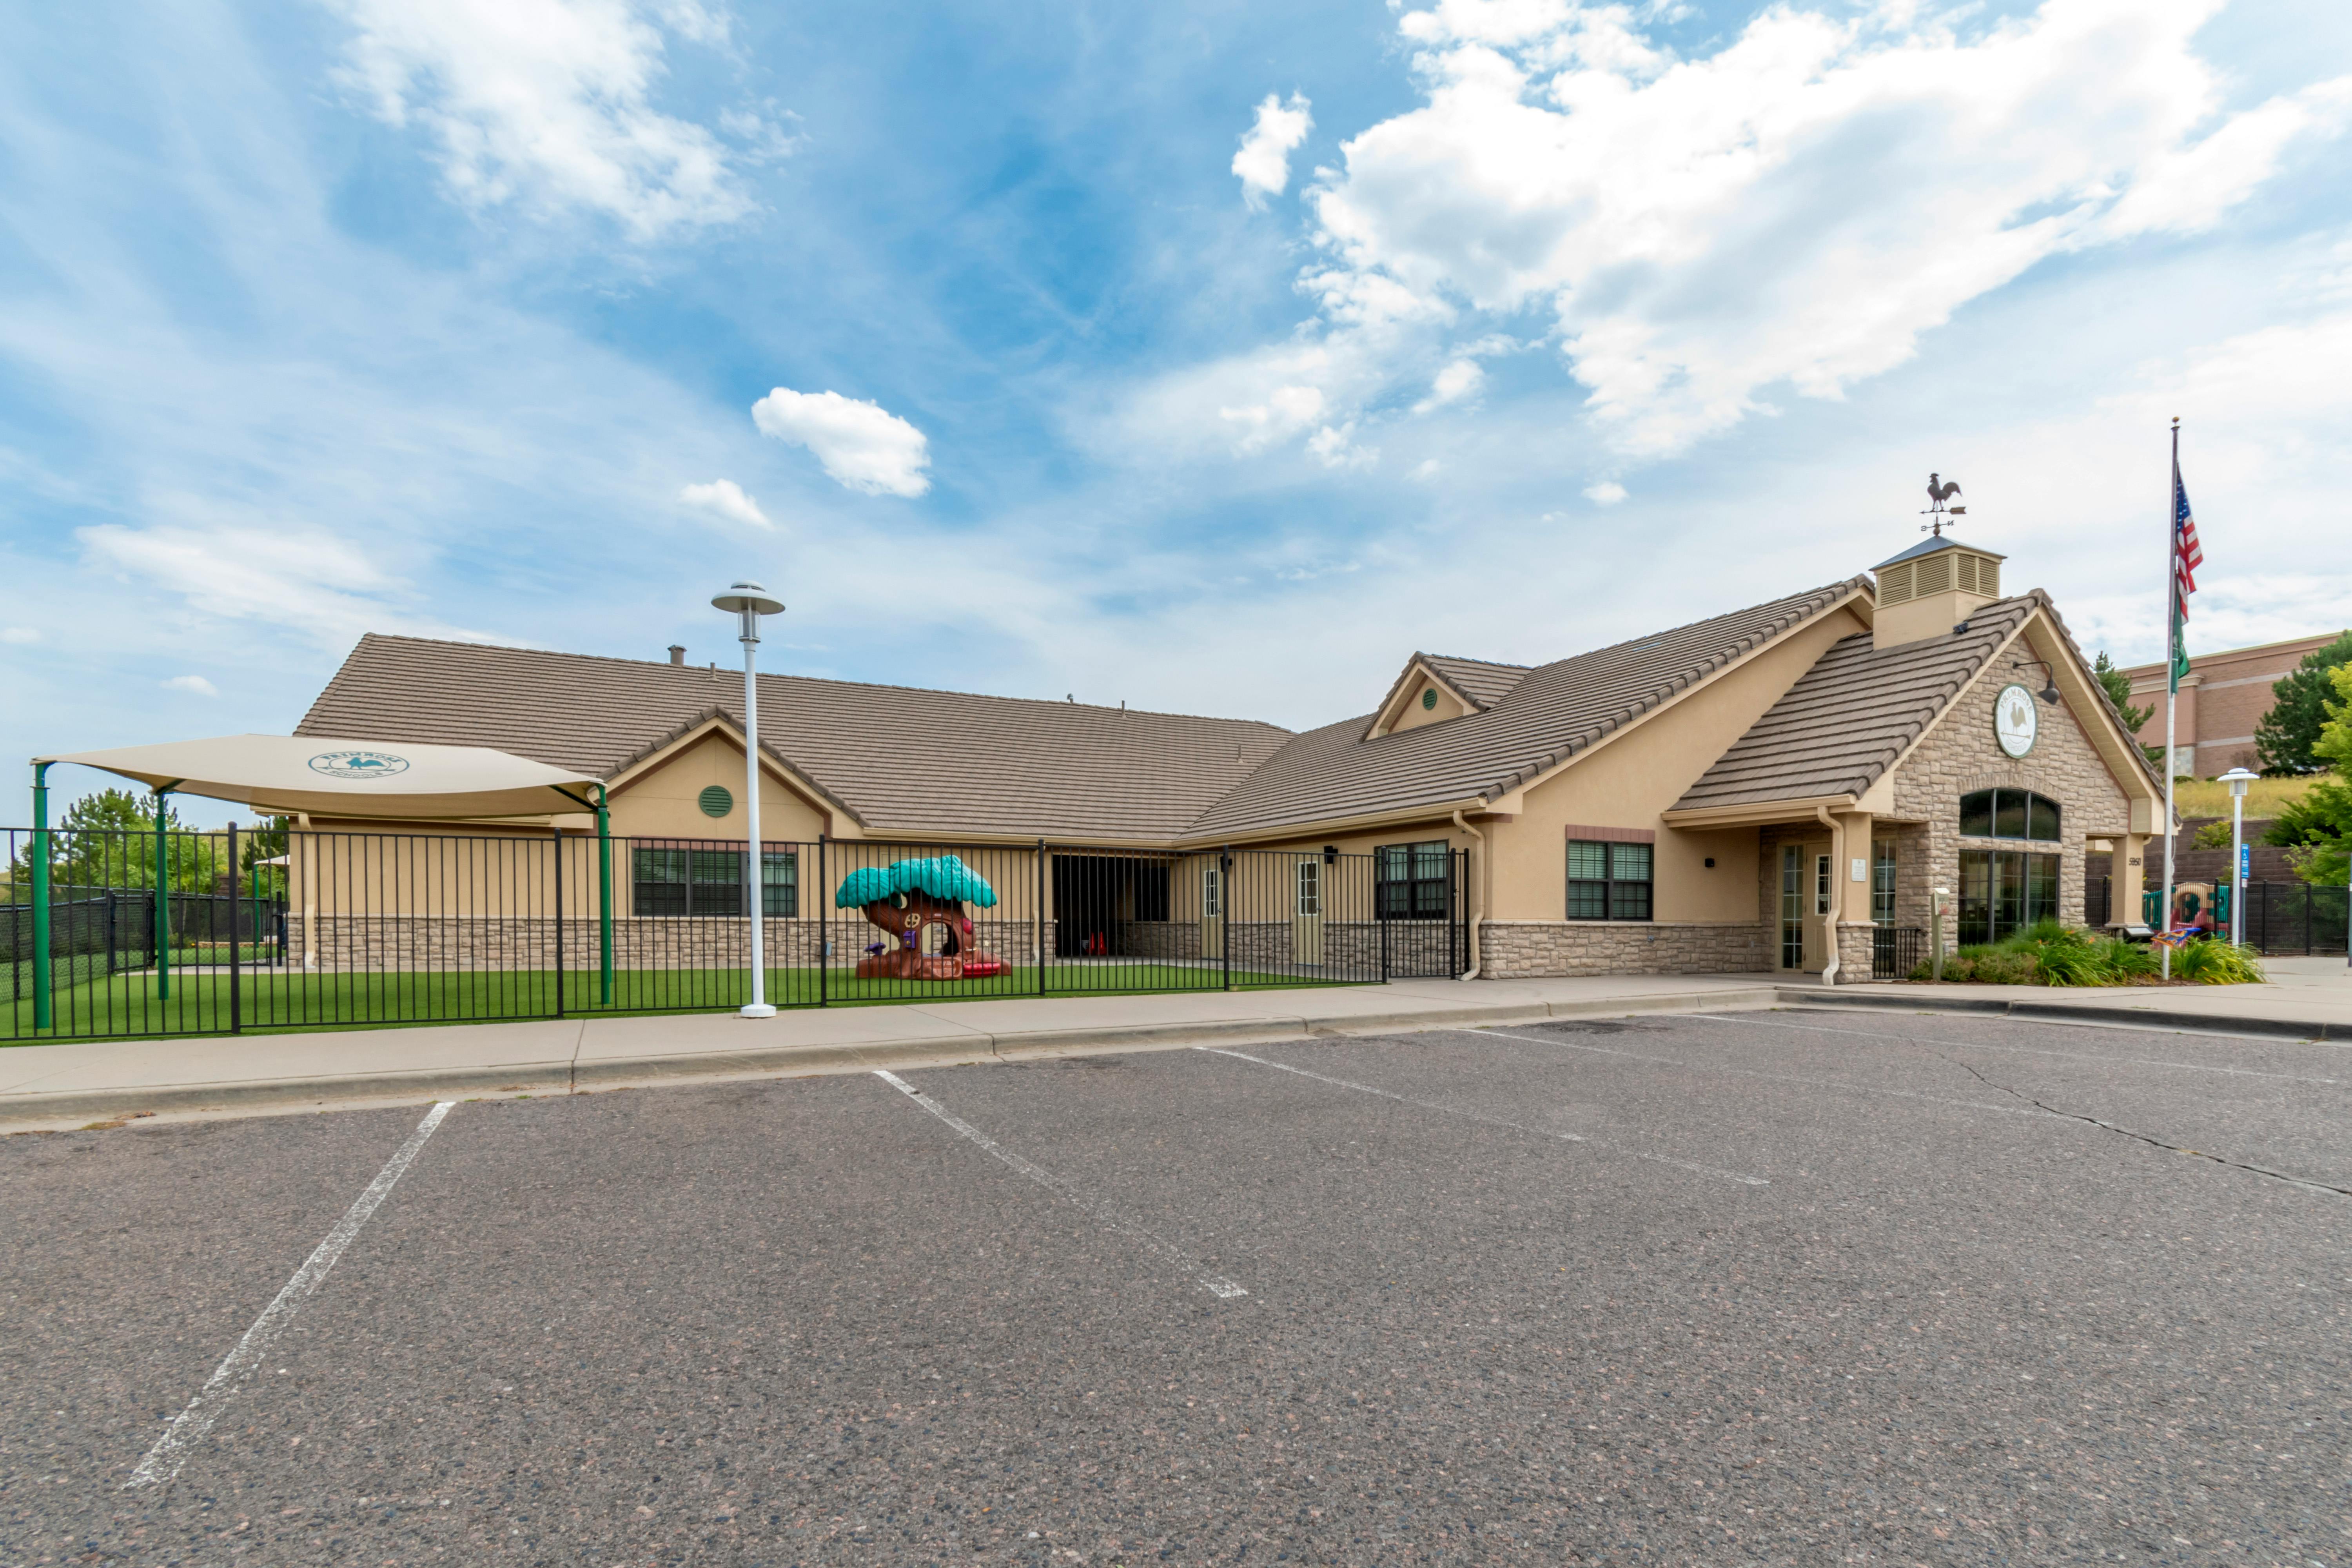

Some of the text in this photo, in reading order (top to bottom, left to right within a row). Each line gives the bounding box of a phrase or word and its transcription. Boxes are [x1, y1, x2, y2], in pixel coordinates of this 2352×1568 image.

[2000, 688, 2033, 713] PRIMROSE
[2005, 739, 2027, 752] SCHOOLS
[319, 752, 403, 762] PRIMROSE
